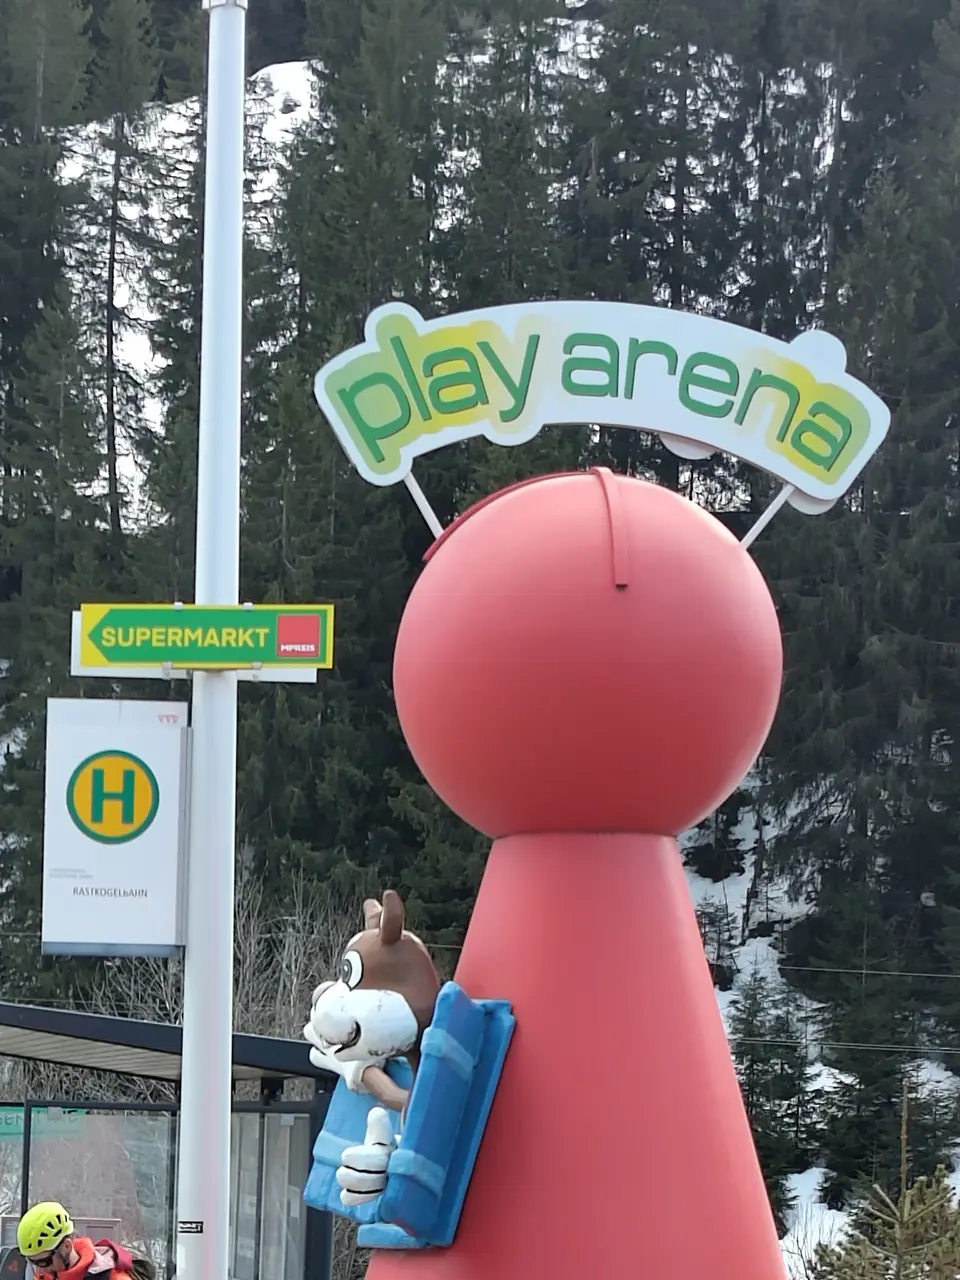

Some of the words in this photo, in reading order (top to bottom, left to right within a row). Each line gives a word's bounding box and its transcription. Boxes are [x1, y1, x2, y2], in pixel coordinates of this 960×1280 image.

[337, 333, 539, 463] play
[560, 332, 853, 471] arena
[101, 627, 270, 648] SUPERMARKT
[91, 768, 136, 824] H
[72, 886, 149, 899] RASTKOGELBAHN
